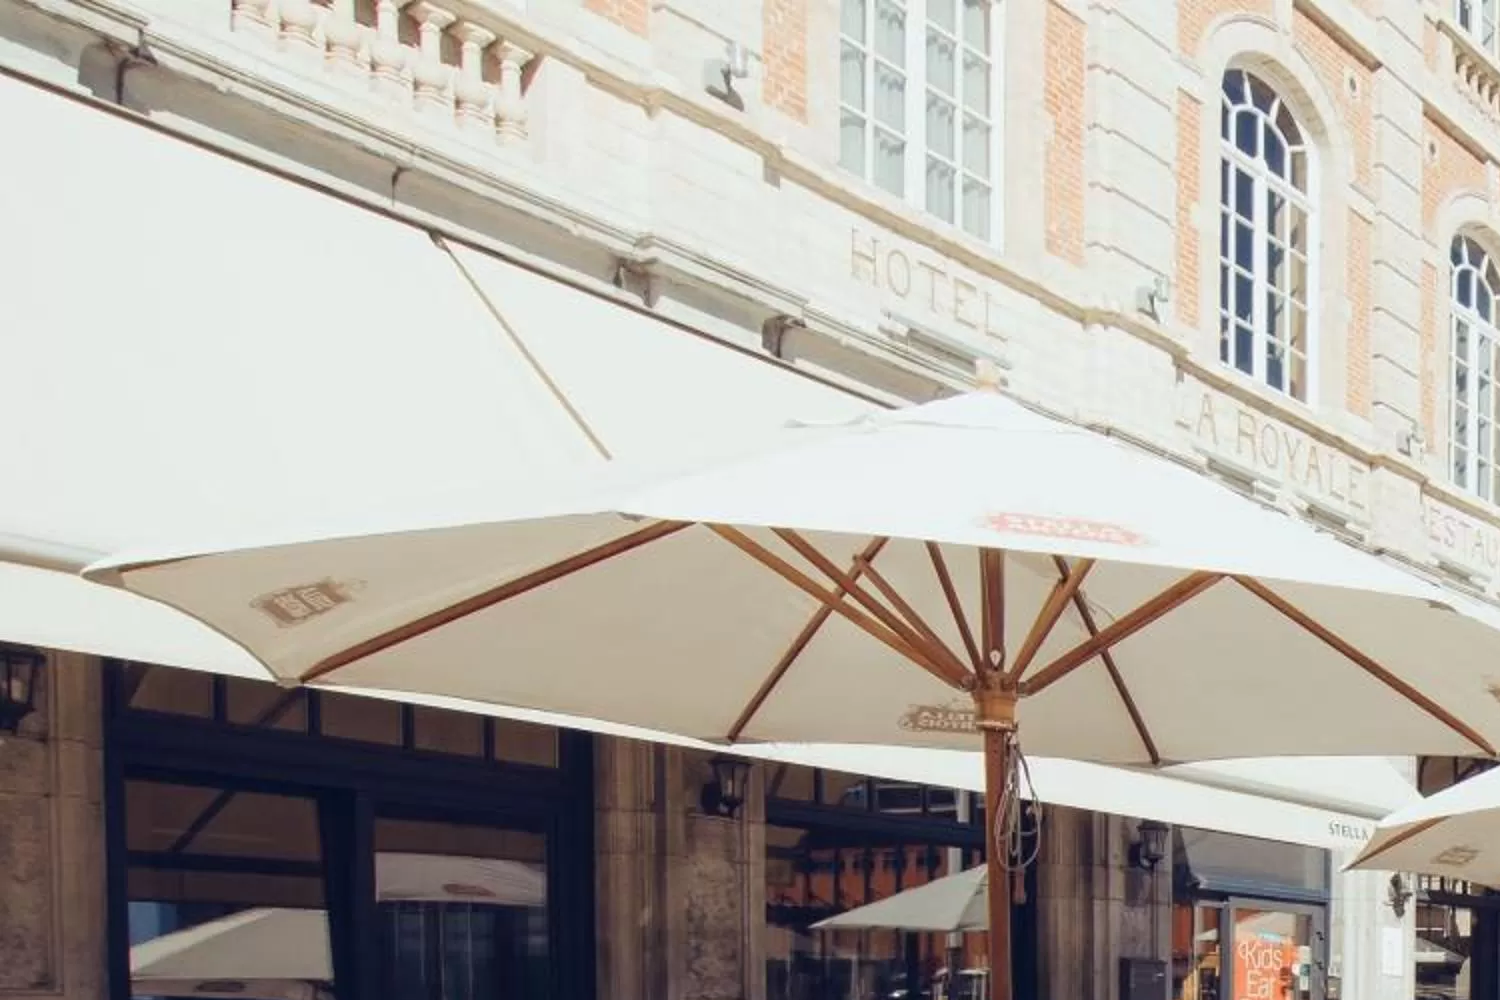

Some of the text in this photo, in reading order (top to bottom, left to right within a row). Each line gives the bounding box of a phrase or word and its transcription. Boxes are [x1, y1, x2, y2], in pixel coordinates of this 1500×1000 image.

[850, 224, 1009, 343] HOTEL
[1236, 408, 1367, 511] ROYALE
[1328, 820, 1369, 841] STELLA
[1238, 940, 1283, 970] Kids
